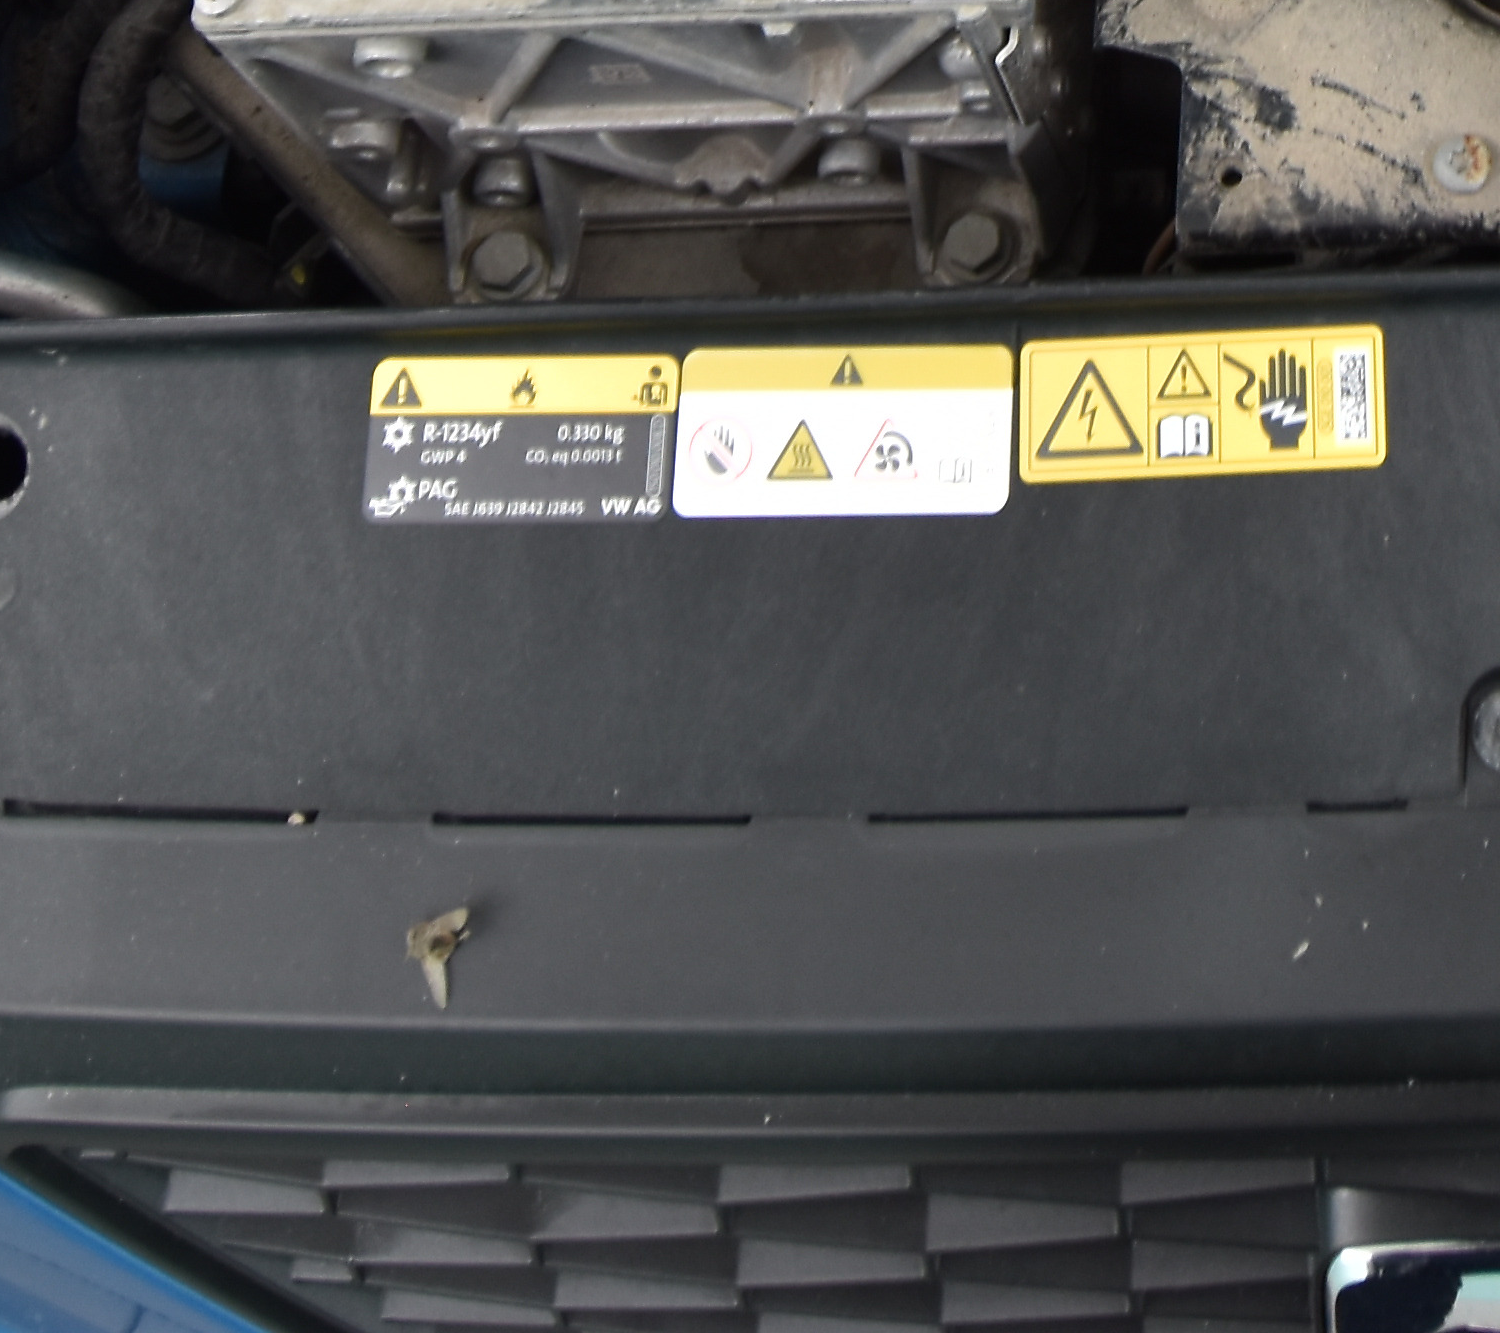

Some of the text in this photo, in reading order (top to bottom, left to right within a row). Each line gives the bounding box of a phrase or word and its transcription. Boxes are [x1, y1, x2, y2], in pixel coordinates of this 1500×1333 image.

[423, 422, 625, 447] R-1234yf 0.330 kg
[421, 450, 453, 464] GWP
[458, 450, 466, 463] 4
[552, 452, 568, 466] eq
[571, 450, 612, 462] 0.0013
[617, 449, 622, 462] t
[418, 480, 458, 499] PAG
[445, 501, 467, 515] SAE
[473, 502, 503, 516] J639
[506, 502, 542, 516] J2842
[601, 499, 631, 515] VW
[634, 498, 662, 514] AG
